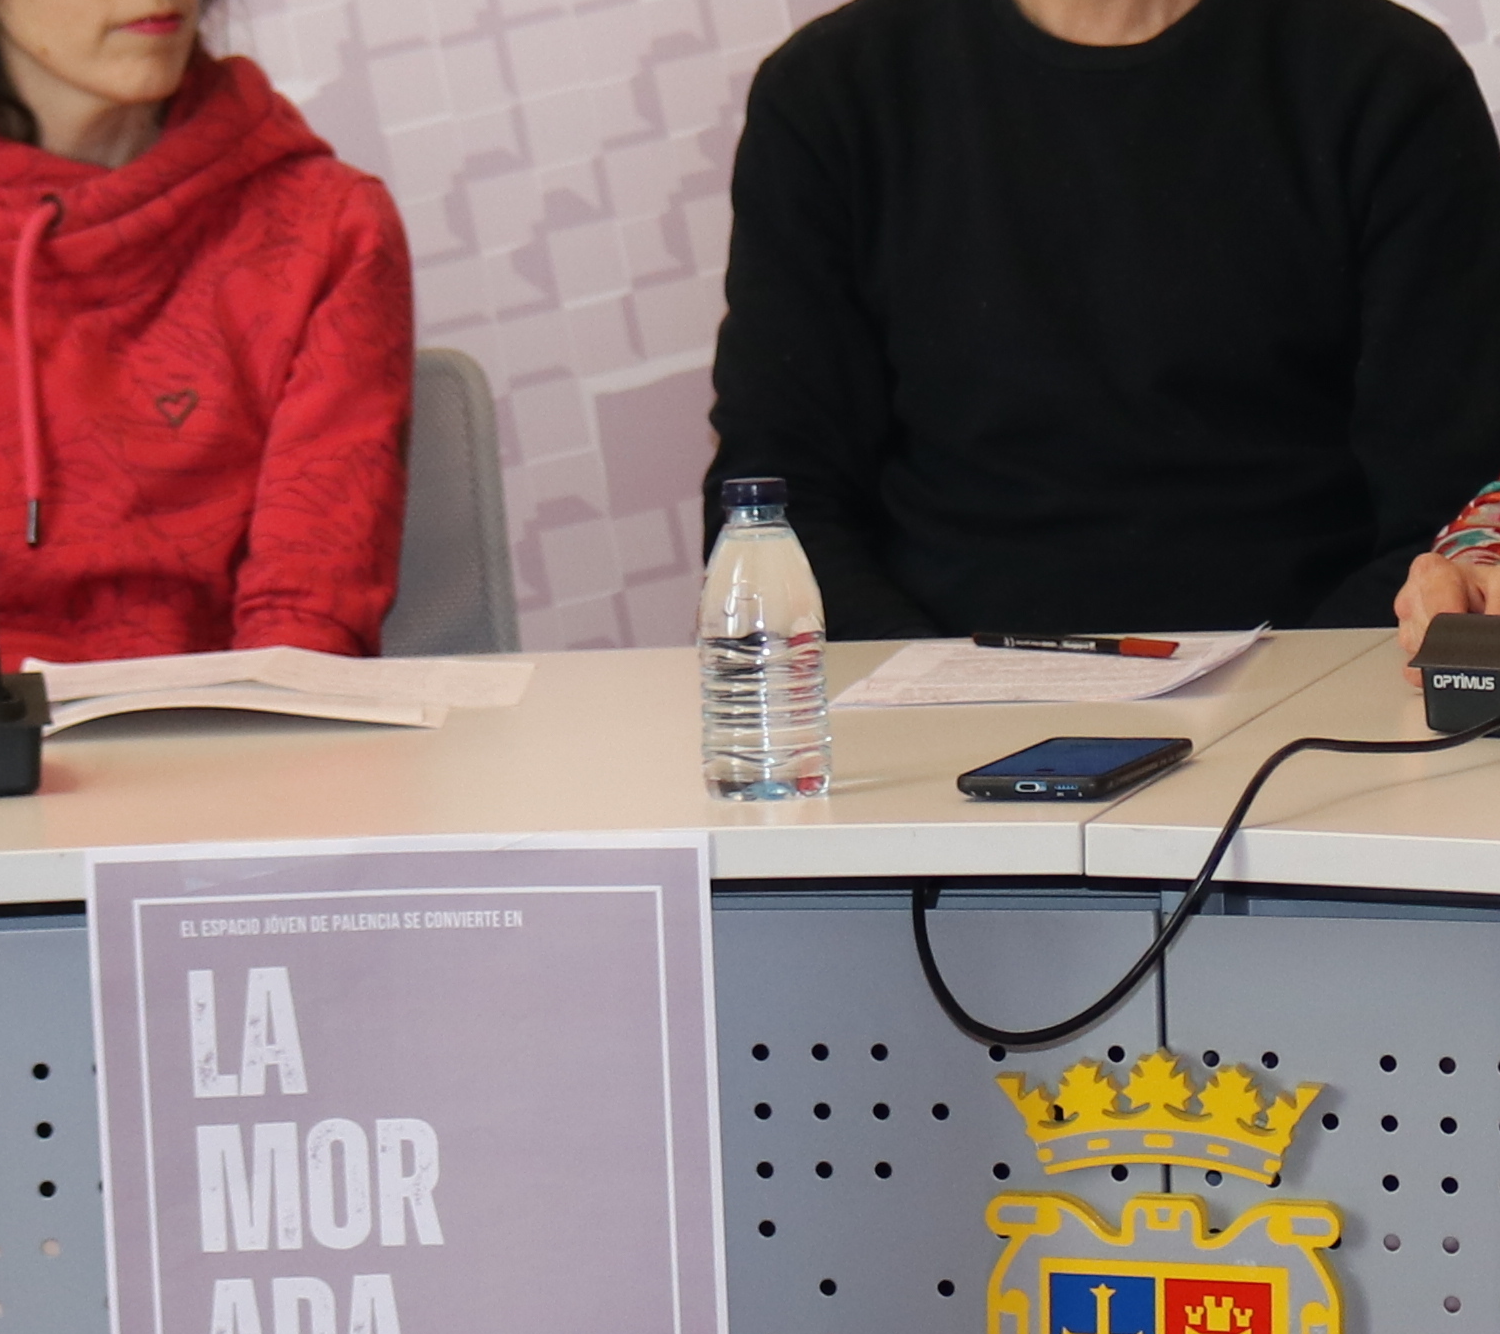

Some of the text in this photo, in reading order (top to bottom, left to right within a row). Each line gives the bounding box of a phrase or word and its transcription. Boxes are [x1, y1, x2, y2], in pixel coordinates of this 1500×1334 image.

[1433, 673, 1495, 690] OPTIMUS
[181, 910, 523, 938] EL ESPACIO JÓVEN DE PALENCIA SE CONVIERTE EN
[188, 965, 308, 1098] LA
[194, 1117, 445, 1254] MOR
